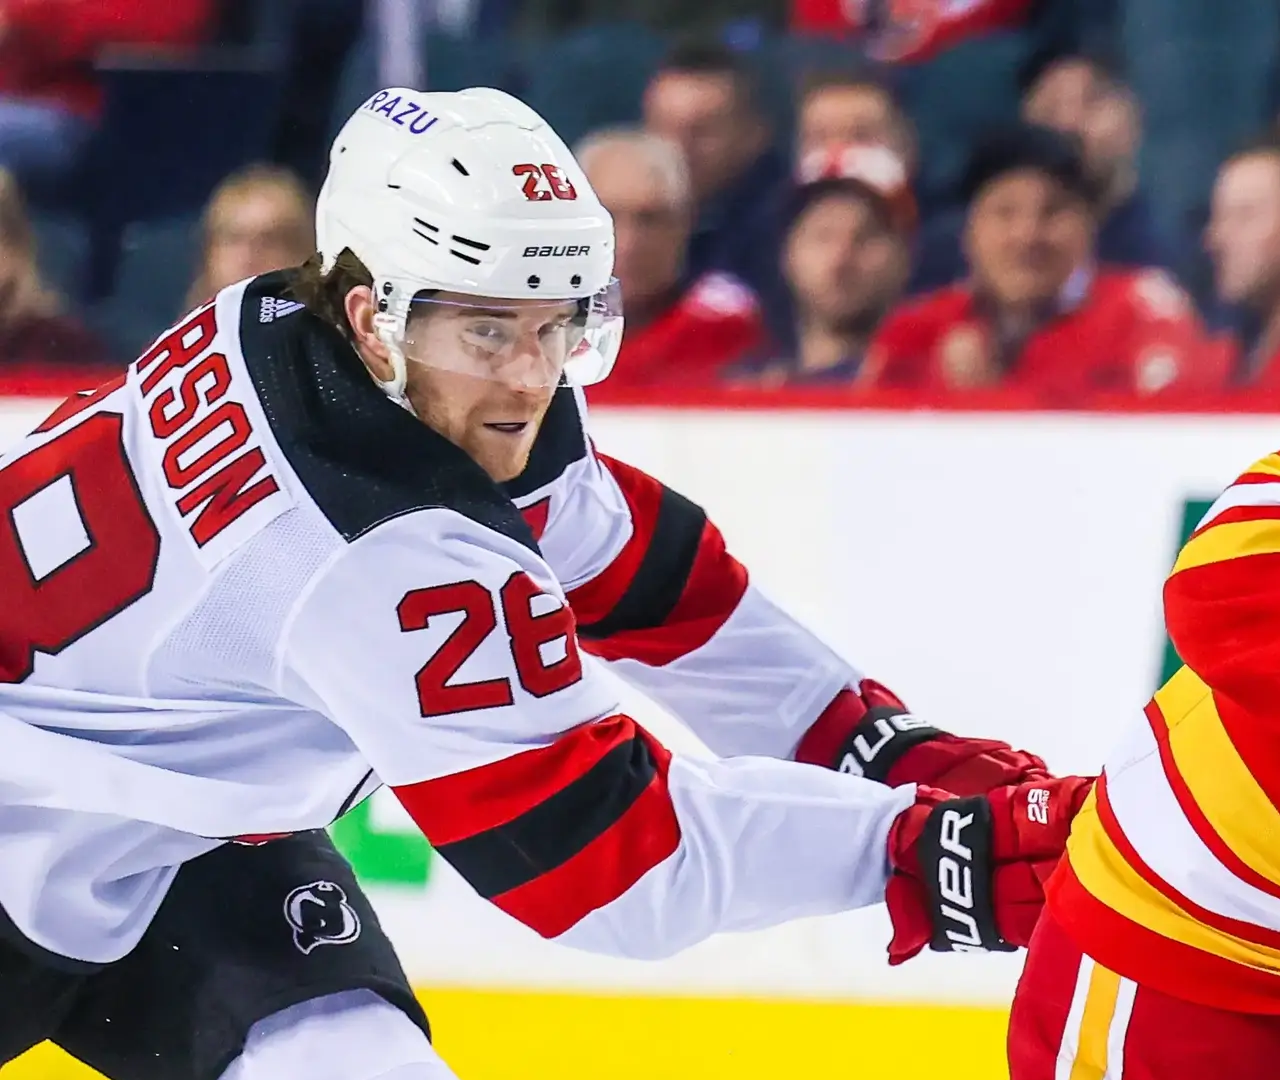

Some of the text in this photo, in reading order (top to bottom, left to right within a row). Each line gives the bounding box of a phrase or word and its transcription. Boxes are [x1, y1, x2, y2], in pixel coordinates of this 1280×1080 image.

[364, 91, 438, 134] RAZU
[512, 163, 578, 201] 28
[522, 245, 590, 258] BAUER
[396, 570, 583, 719] 28
